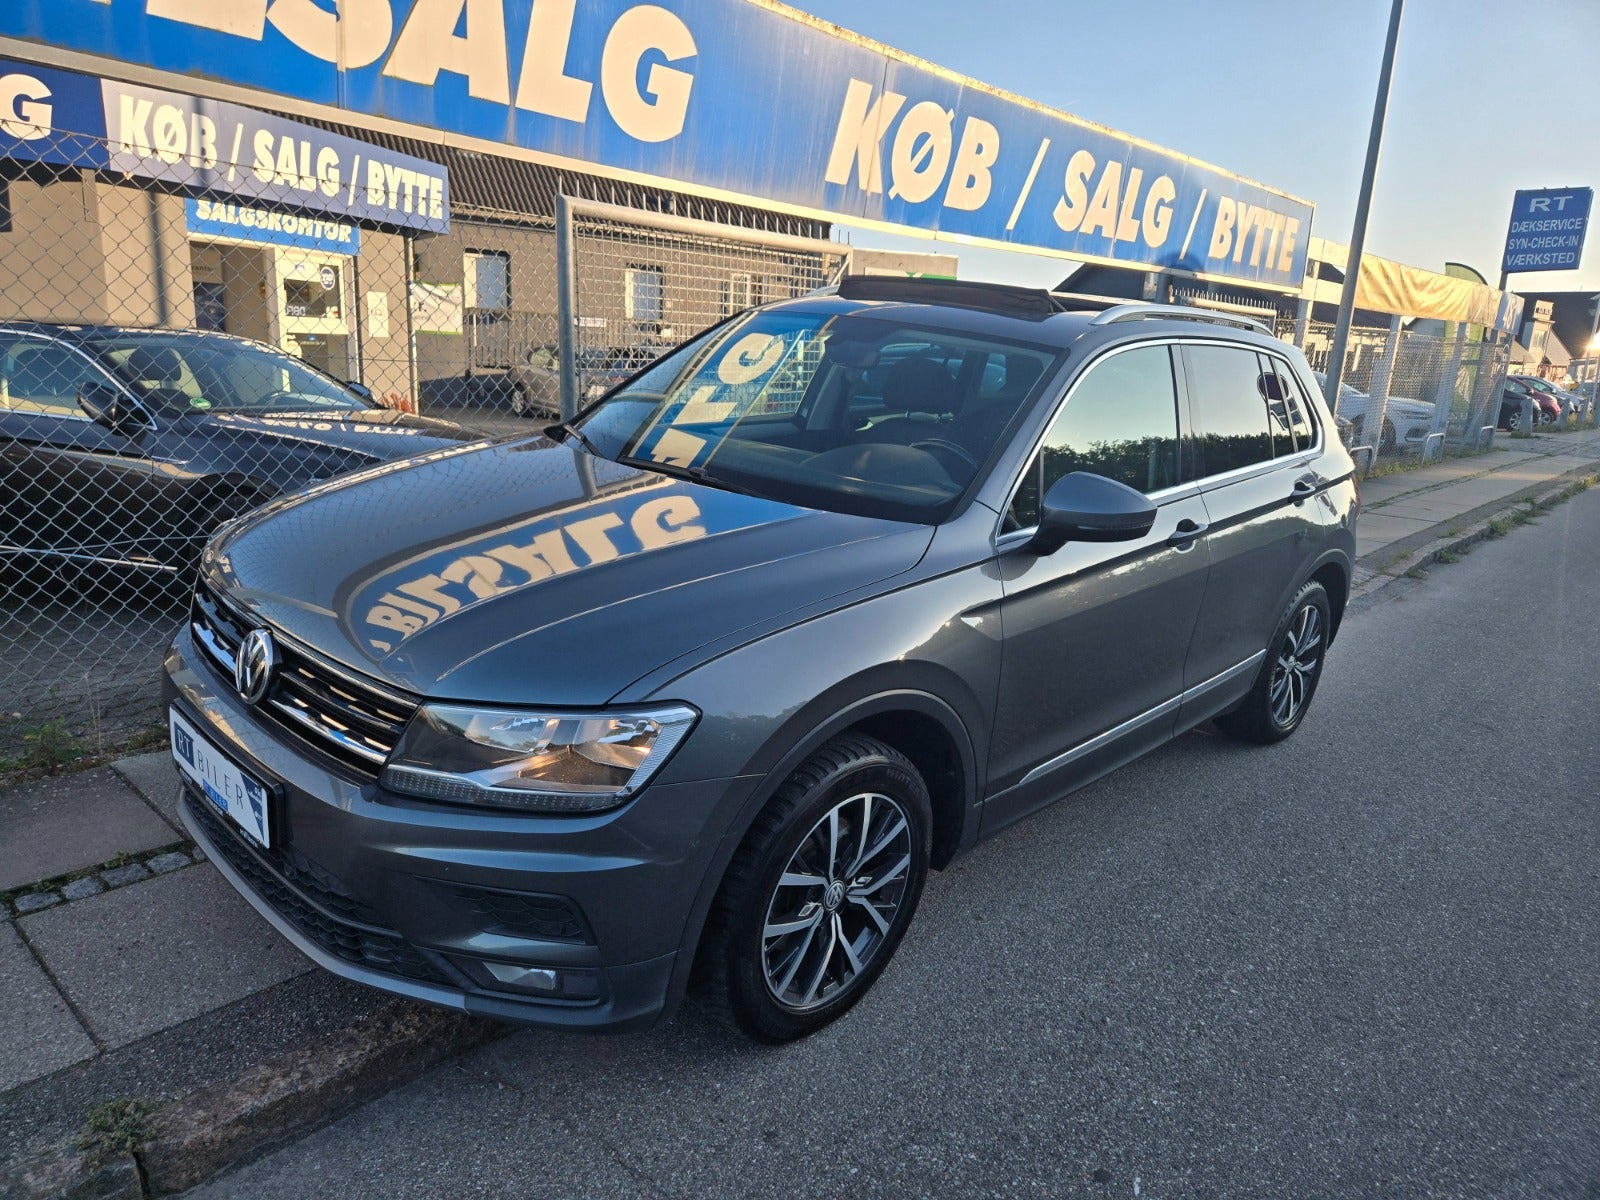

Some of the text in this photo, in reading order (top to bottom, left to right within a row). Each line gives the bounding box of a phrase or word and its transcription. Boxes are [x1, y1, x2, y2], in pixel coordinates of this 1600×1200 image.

[119, 94, 217, 170] KØB
[253, 129, 340, 197] SALG
[367, 159, 443, 220] BYTTE
[825, 77, 1000, 211] KØB
[1053, 150, 1176, 248] SALG
[1208, 195, 1300, 272] BYTTE
[1529, 196, 1573, 212] RT
[195, 199, 352, 243] SALGSKONTOR
[1511, 218, 1583, 233] DÆKSERVICE
[1508, 235, 1579, 249] SYN-CHECK-IN
[1506, 252, 1575, 266] VÆRKSTED
[177, 728, 191, 759] RT
[197, 749, 244, 810] BILER
